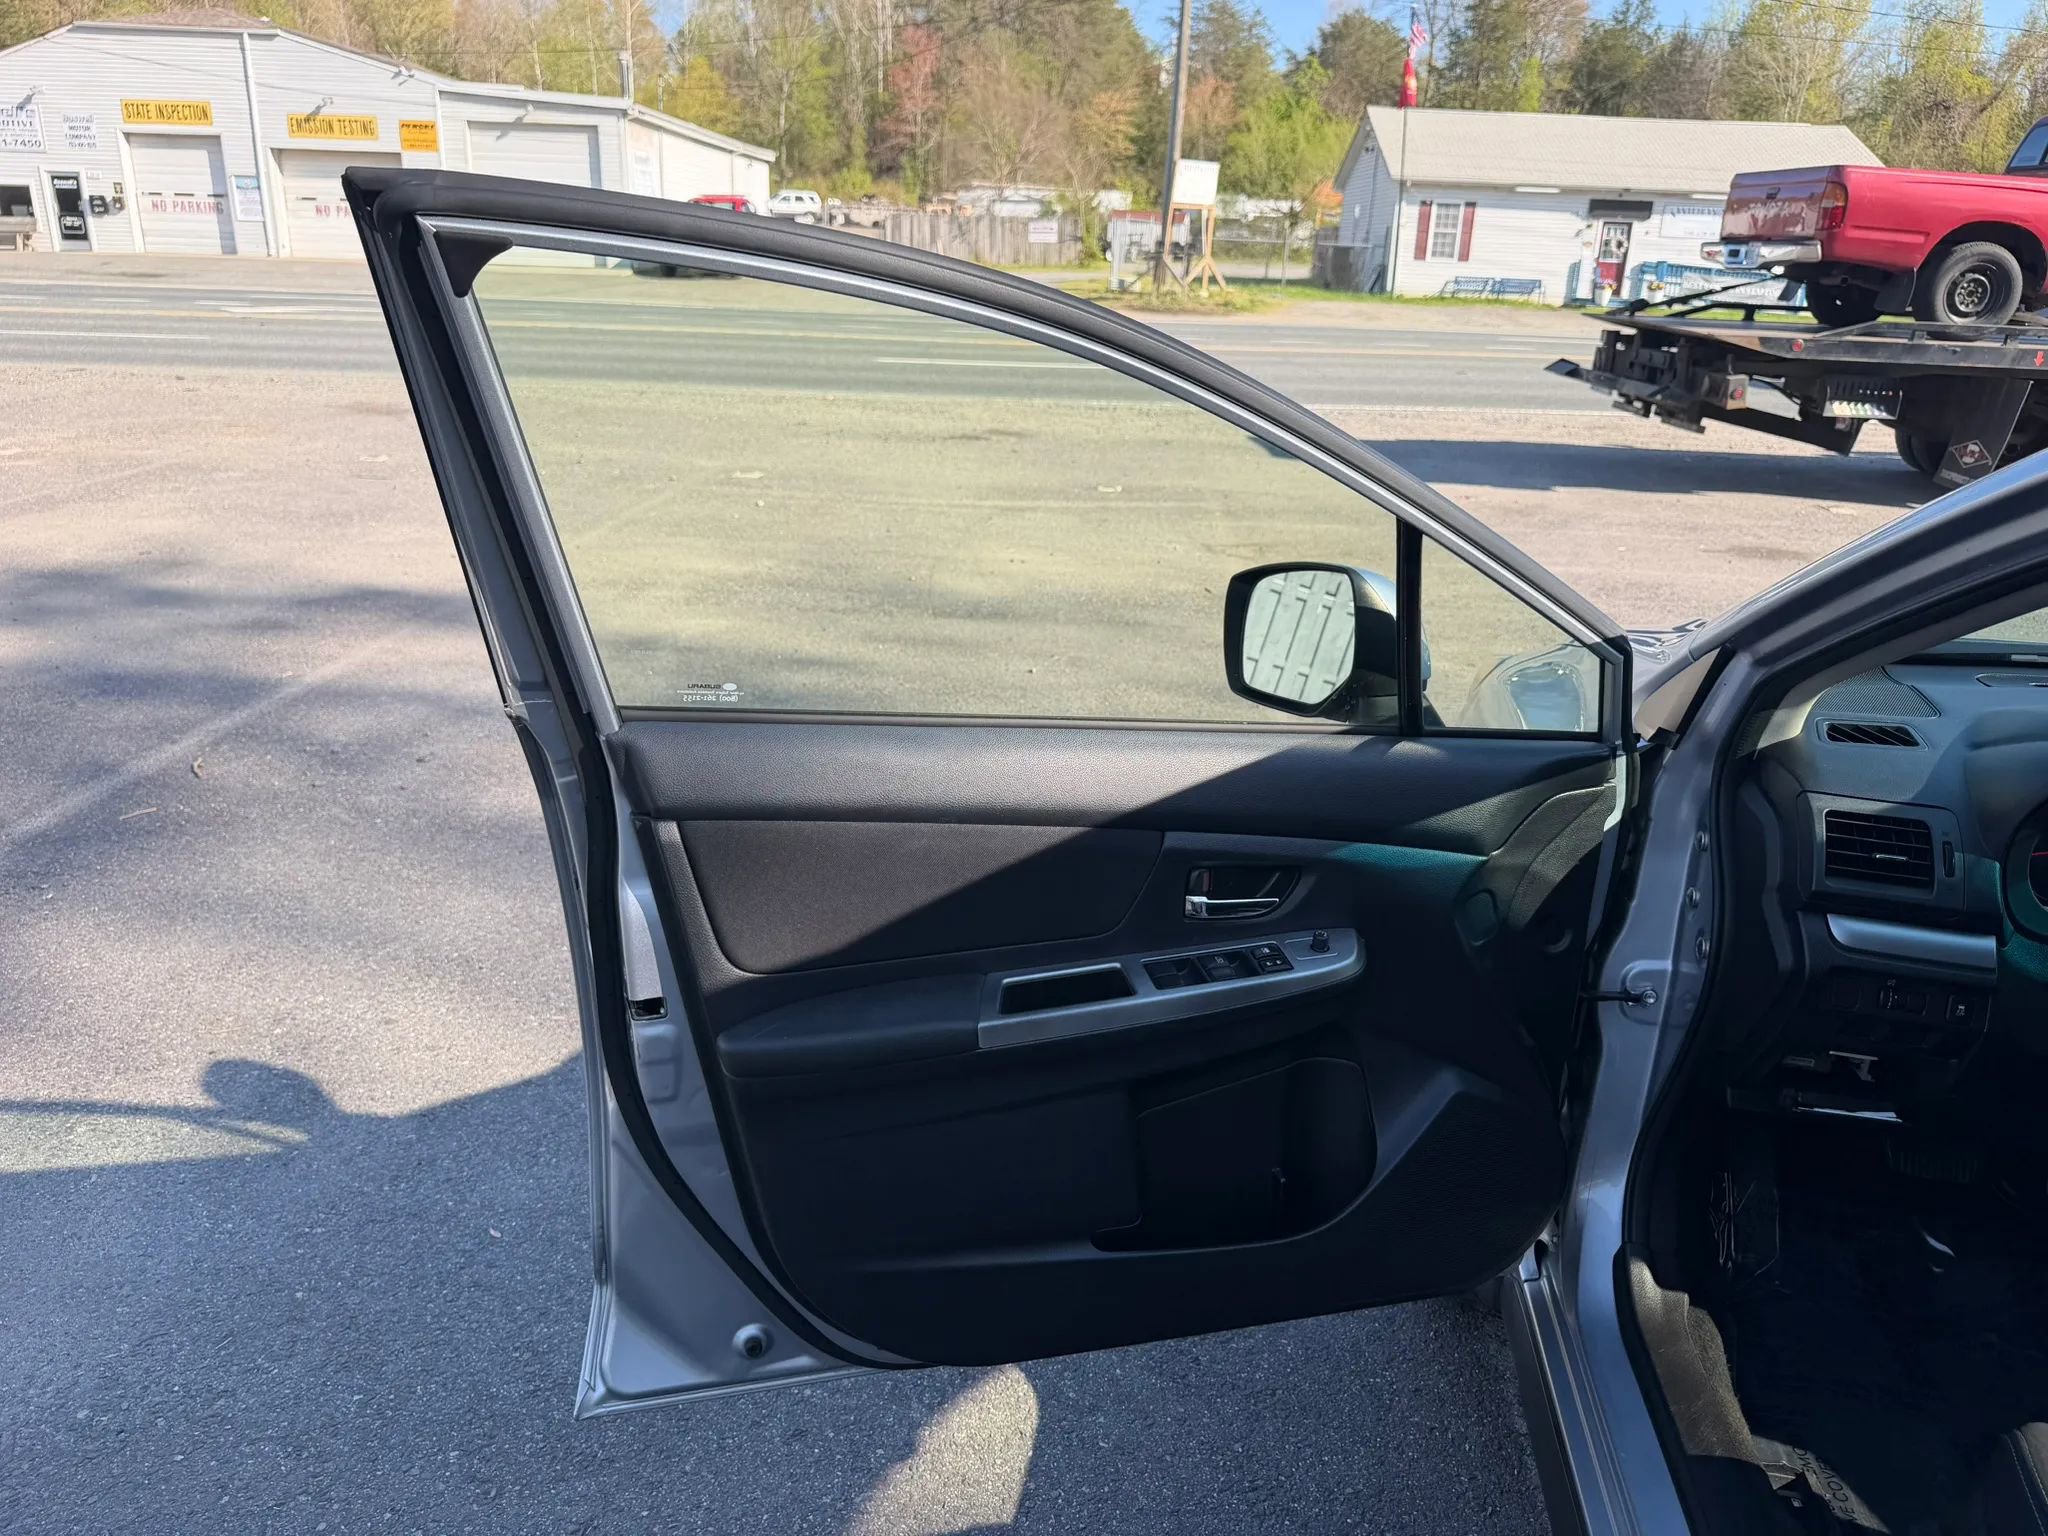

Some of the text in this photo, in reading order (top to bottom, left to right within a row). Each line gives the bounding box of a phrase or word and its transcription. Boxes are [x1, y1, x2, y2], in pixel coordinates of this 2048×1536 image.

[124, 103, 209, 121] STATE INSPECTION
[290, 116, 375, 136] EMISSION TESTING
[151, 200, 167, 212] NO
[172, 200, 224, 215] PARKING
[314, 204, 331, 217] NO
